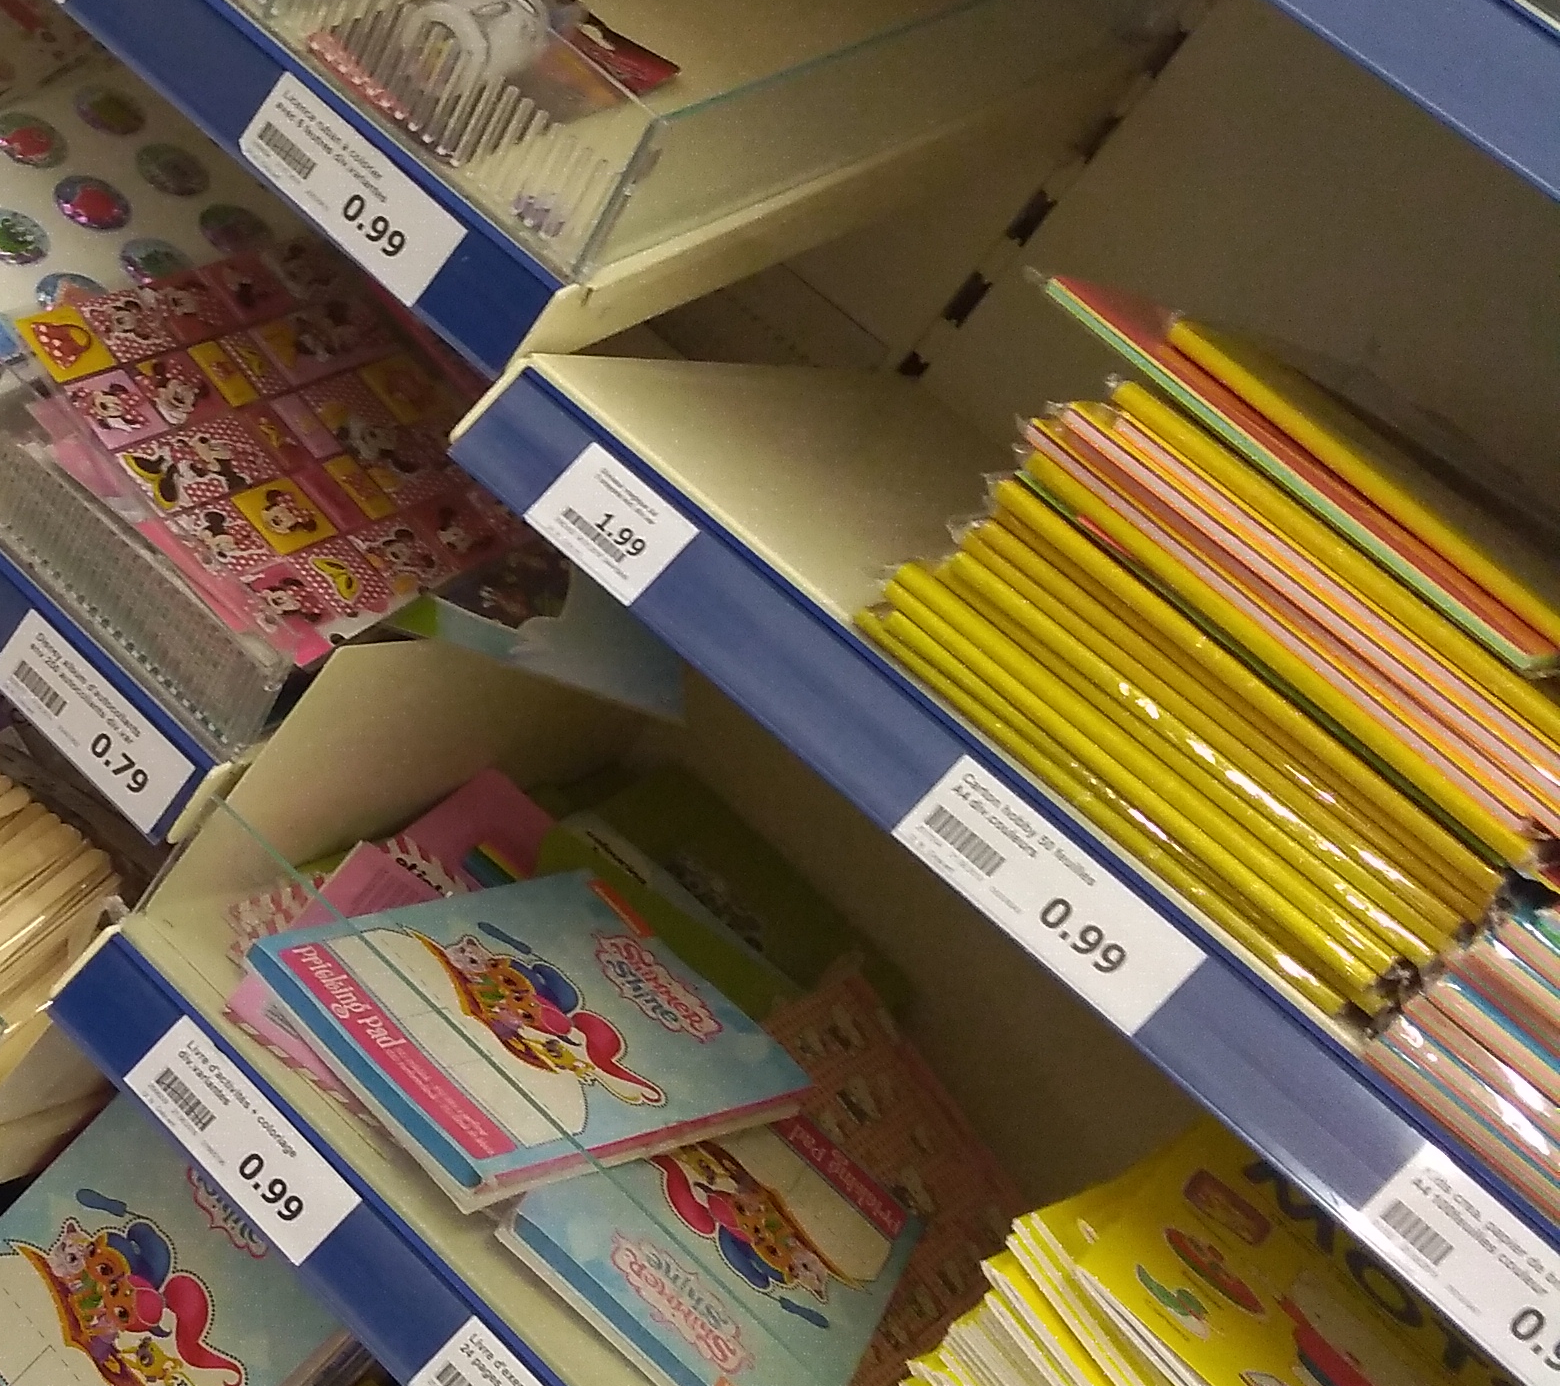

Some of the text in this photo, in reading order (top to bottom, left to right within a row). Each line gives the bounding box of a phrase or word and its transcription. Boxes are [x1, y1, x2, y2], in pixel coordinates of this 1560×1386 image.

[341, 192, 407, 262] 0.99
[594, 511, 648, 558] 1.99
[34, 631, 64, 663] Disney
[62, 658, 89, 686] album
[88, 731, 150, 798] 0.79
[951, 783, 972, 802] A4
[960, 771, 1099, 888] Carton hobby feuilles
[1036, 895, 1130, 978] 0.99
[283, 936, 406, 1058] Pricking Pad
[185, 1039, 300, 1162] Livre d'activités coloriage
[235, 1149, 307, 1226] 0.99
[785, 1122, 910, 1234] Pricking Pad
[458, 1342, 475, 1360] 24
[467, 1332, 497, 1363] Livre
